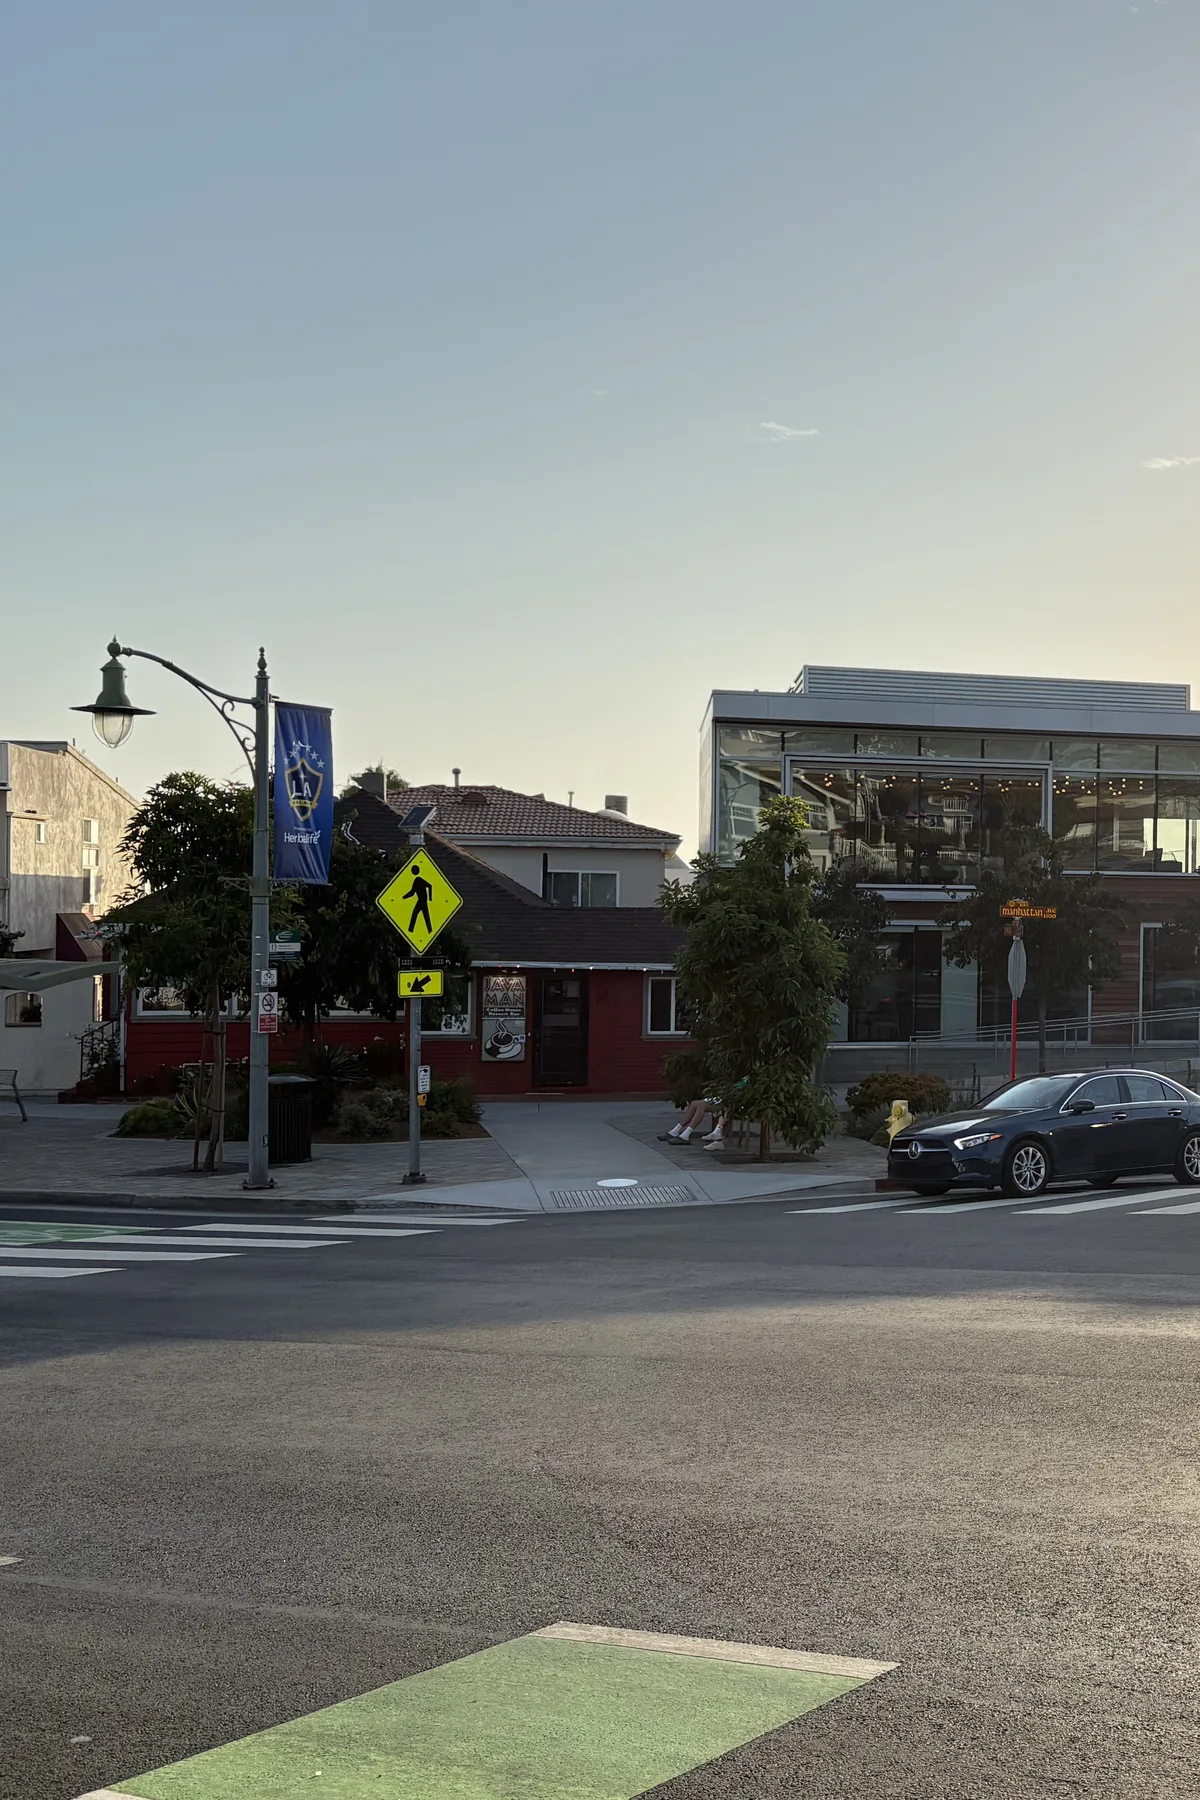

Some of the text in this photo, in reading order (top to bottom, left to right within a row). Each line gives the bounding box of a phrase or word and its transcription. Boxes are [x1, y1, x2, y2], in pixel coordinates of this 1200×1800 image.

[292, 780, 312, 798] LA
[284, 832, 318, 844] Herbalife
[485, 978, 525, 992] JAVA
[484, 992, 524, 1006] MAN
